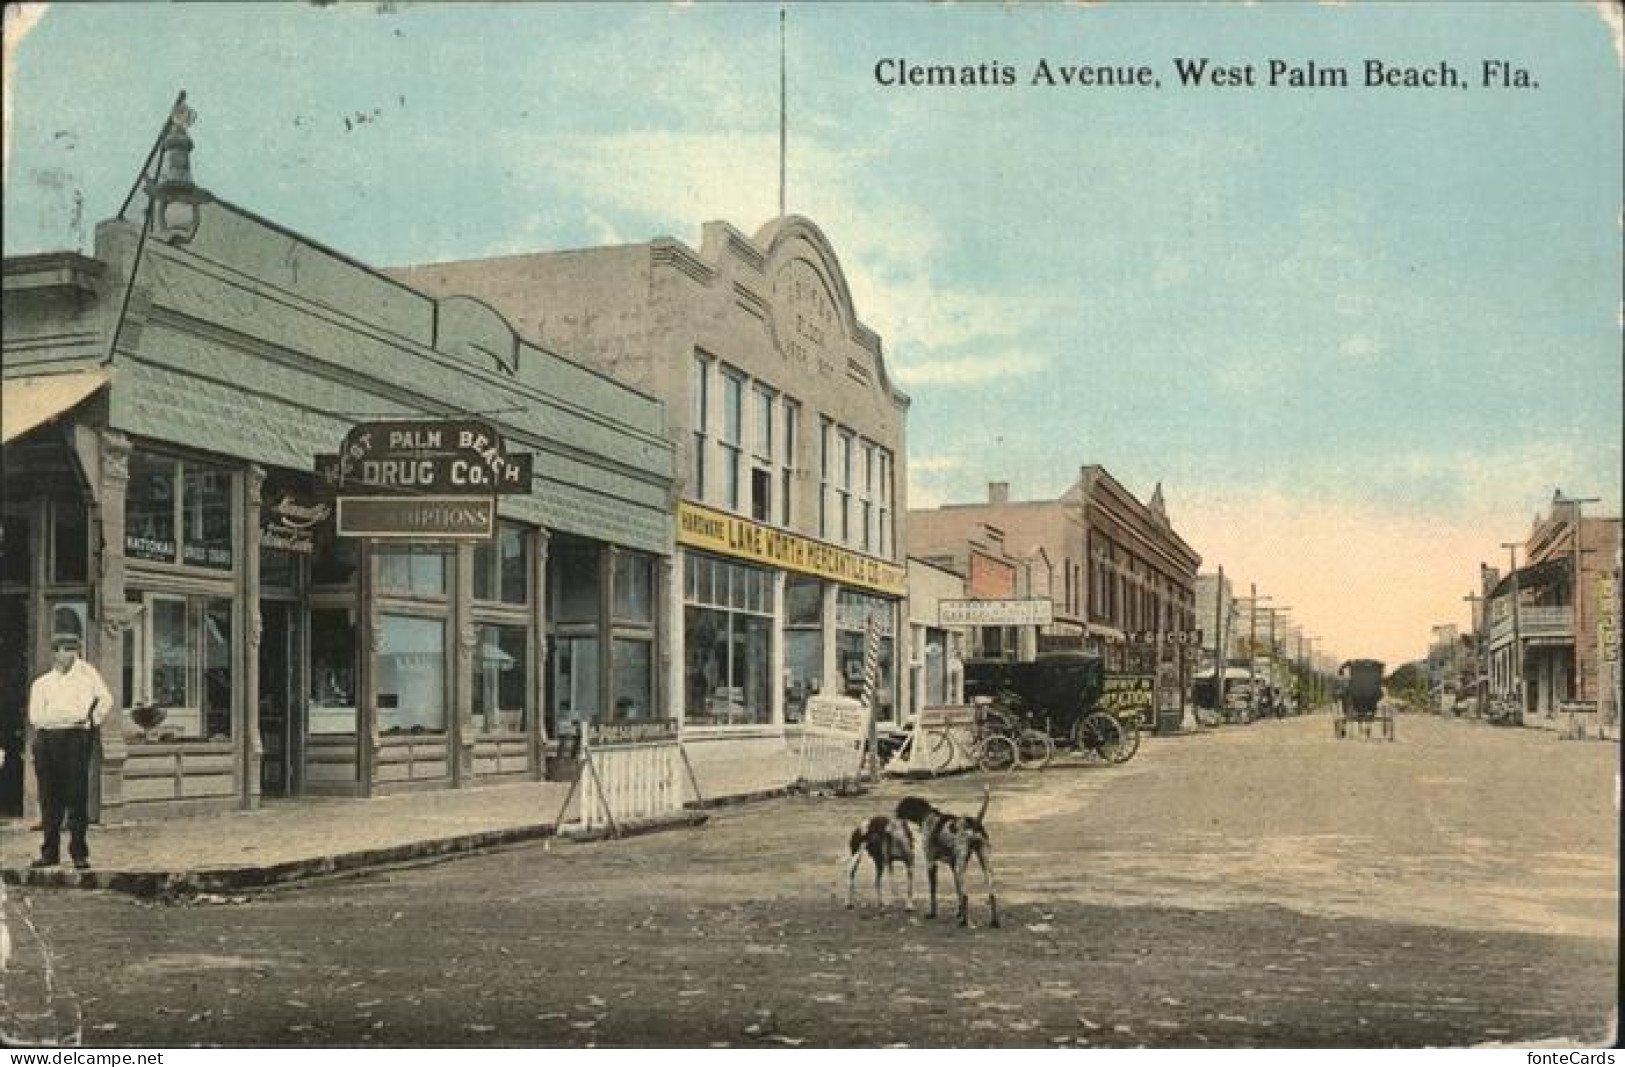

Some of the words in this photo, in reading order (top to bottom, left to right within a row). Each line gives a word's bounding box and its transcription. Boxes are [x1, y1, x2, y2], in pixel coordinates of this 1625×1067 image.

[363, 460, 435, 485] DRUG
[451, 460, 489, 485] Co.
[389, 430, 442, 449] PALM
[458, 430, 520, 482] BEACH
